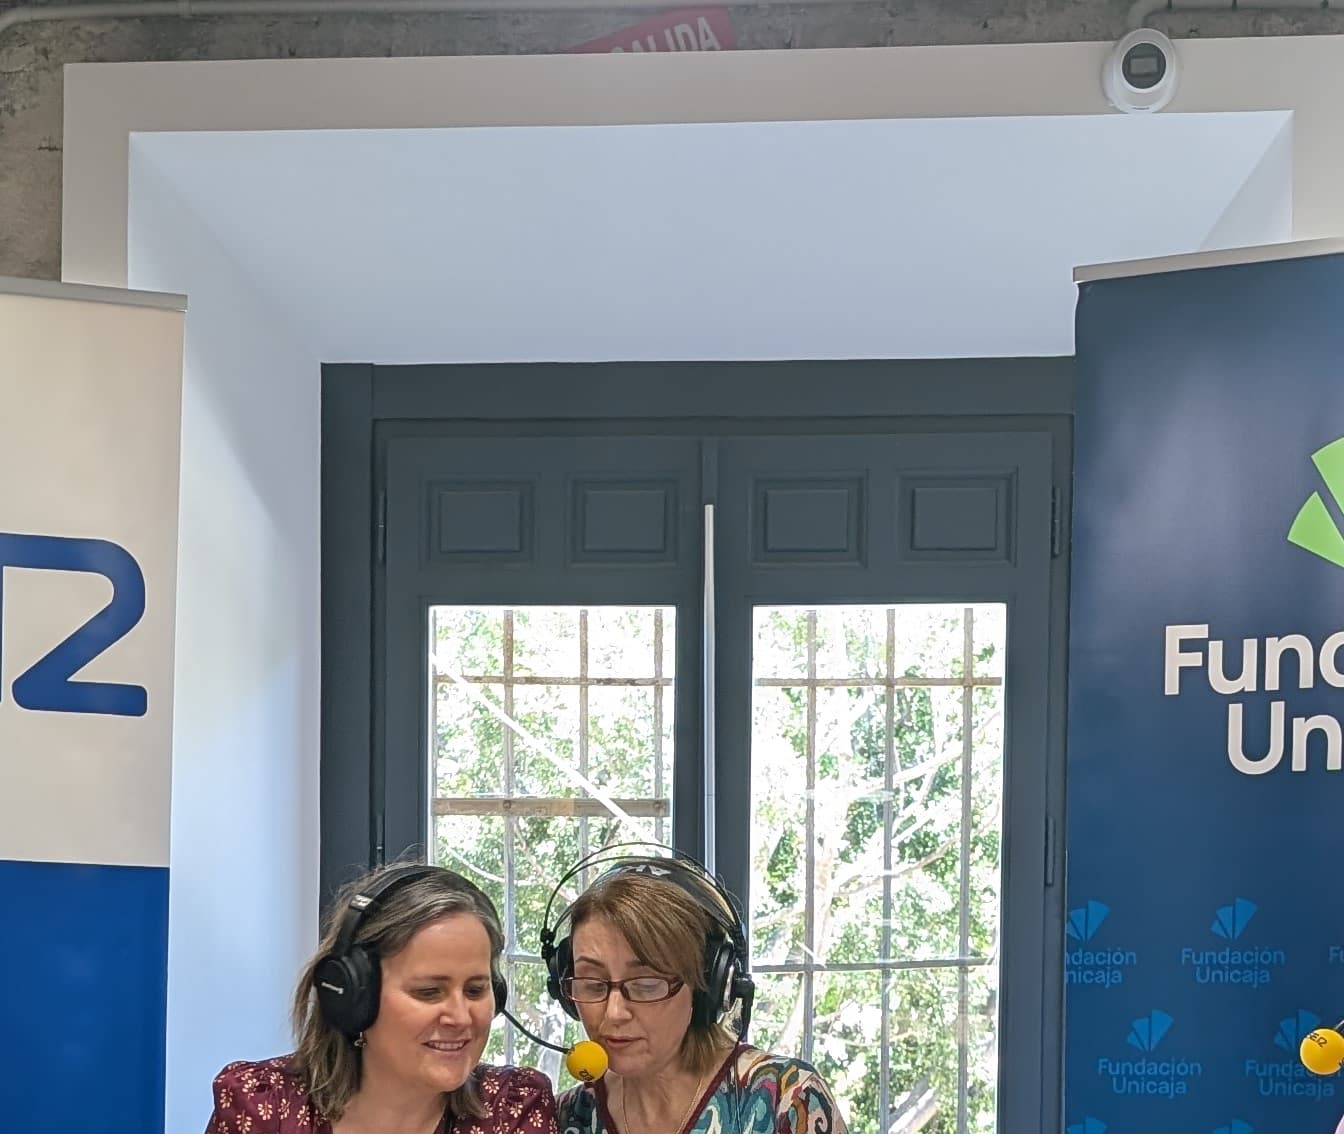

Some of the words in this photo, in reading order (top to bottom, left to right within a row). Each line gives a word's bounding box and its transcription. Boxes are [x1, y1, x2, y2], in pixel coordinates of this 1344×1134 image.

[610, 16, 721, 53] ALIDA
[1182, 947, 1285, 966] Fundación
[1195, 966, 1270, 988] Unicaja
[1098, 1058, 1202, 1077] Fundación
[1111, 1076, 1187, 1098] Unicaja
[1259, 1079, 1335, 1101] Unicaja
